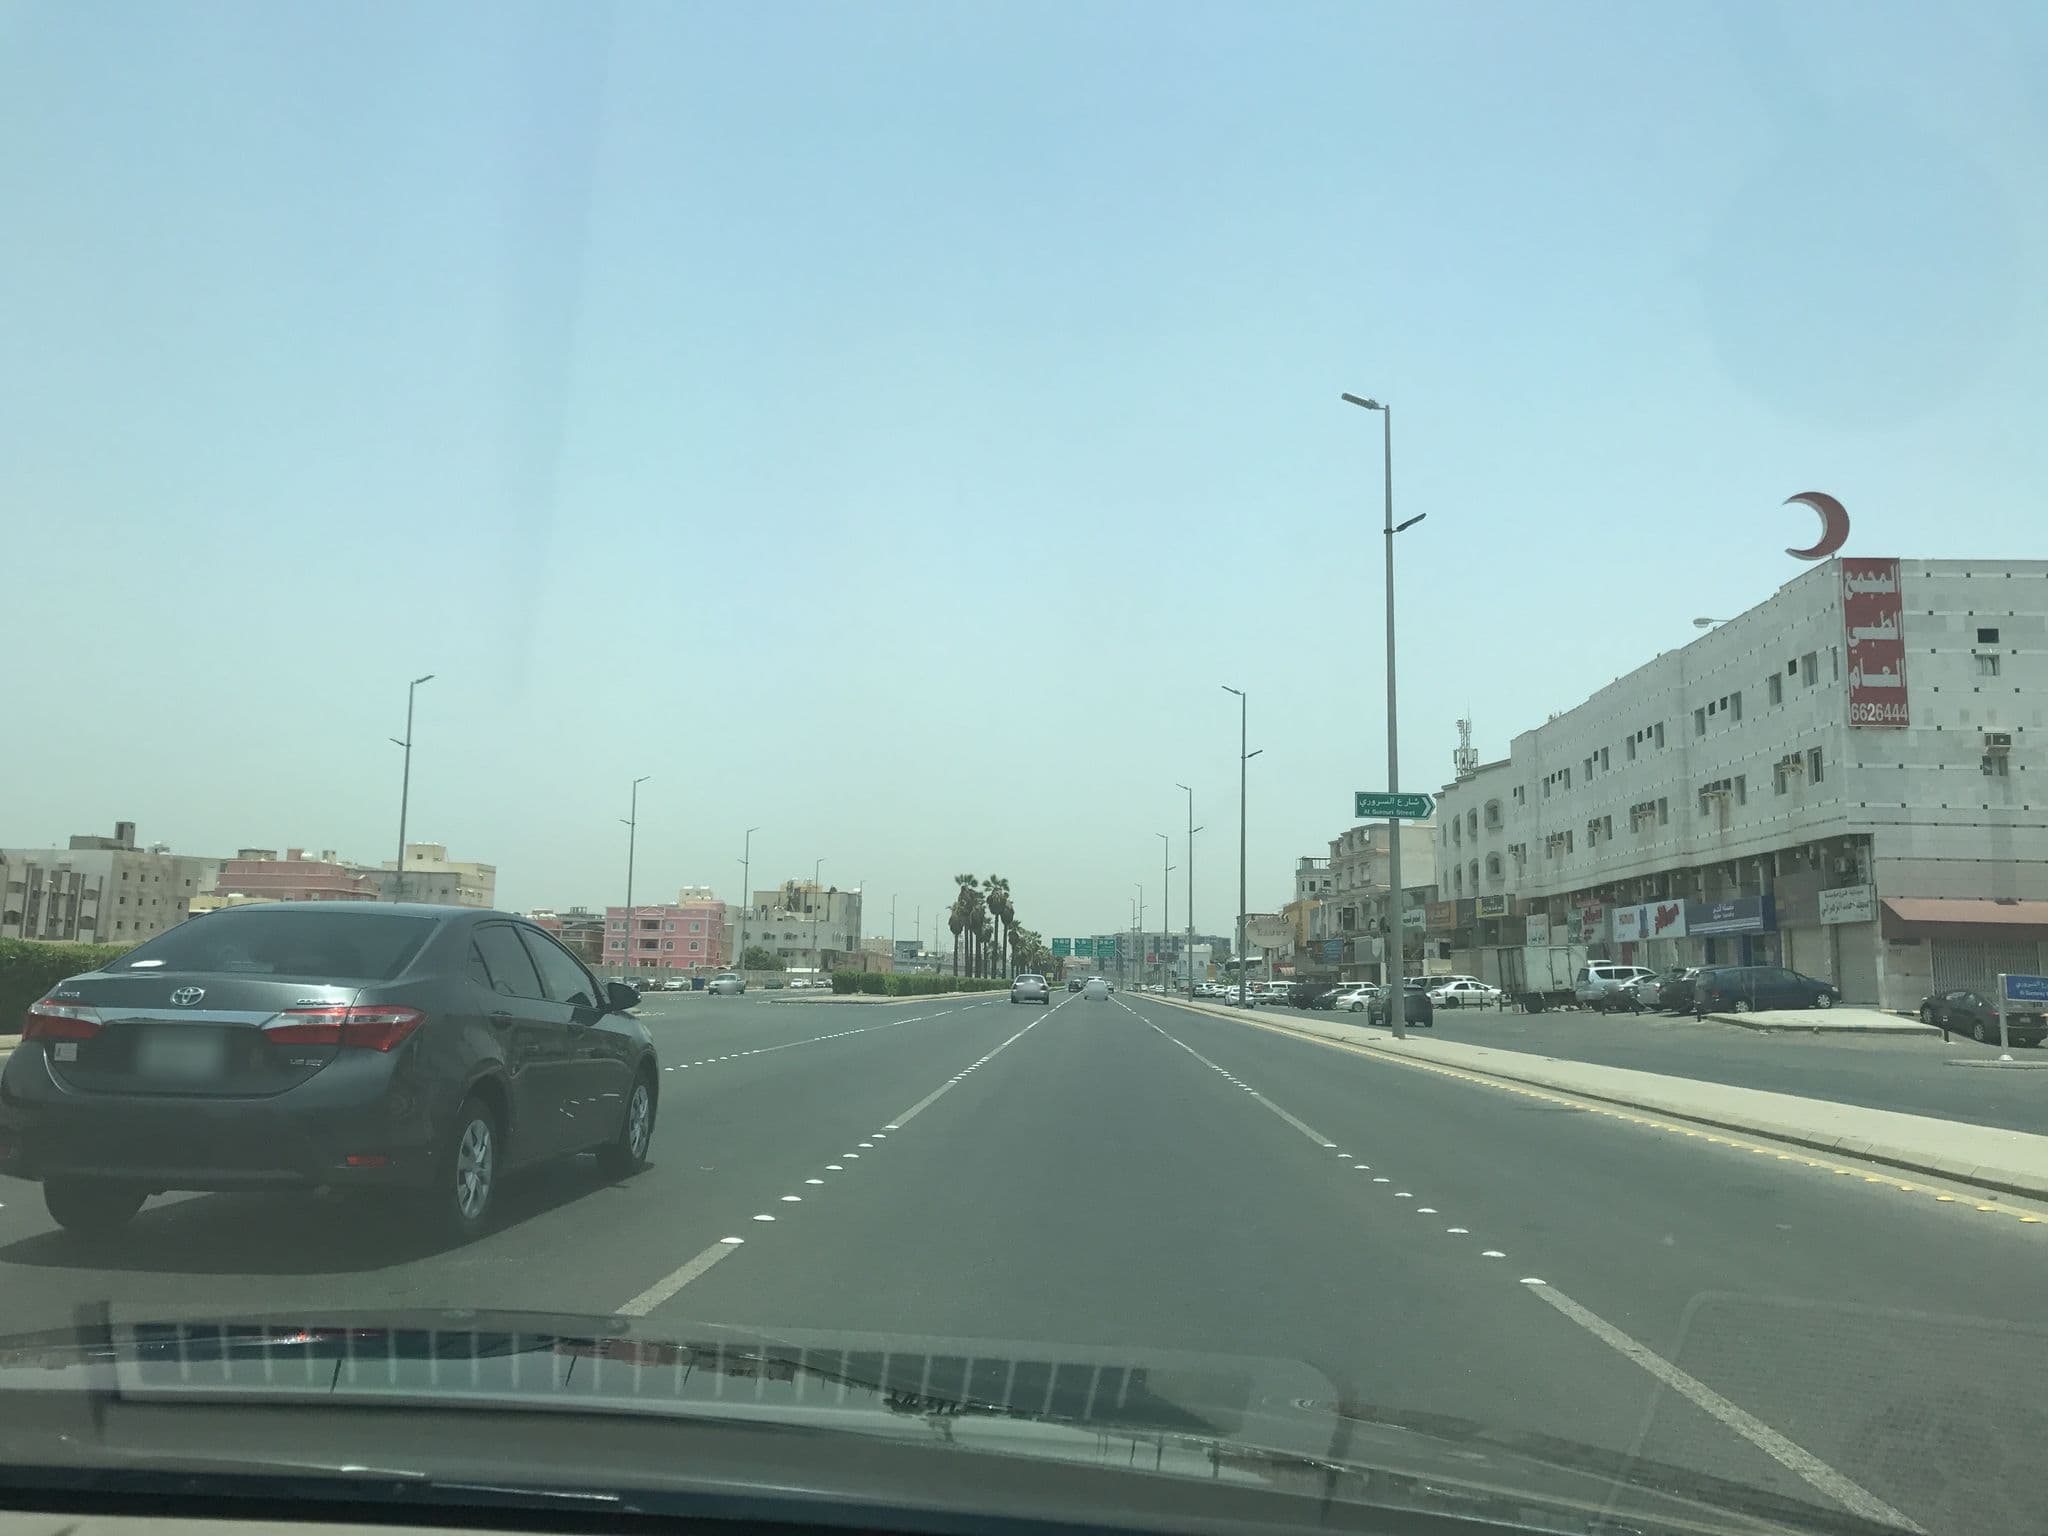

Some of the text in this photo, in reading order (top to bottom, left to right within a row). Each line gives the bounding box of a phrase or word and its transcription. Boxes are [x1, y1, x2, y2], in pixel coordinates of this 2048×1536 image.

[1847, 610, 1903, 654] الطبي
[1852, 703, 1907, 722] 6626444
[1360, 798, 1419, 808] شارع السروري
